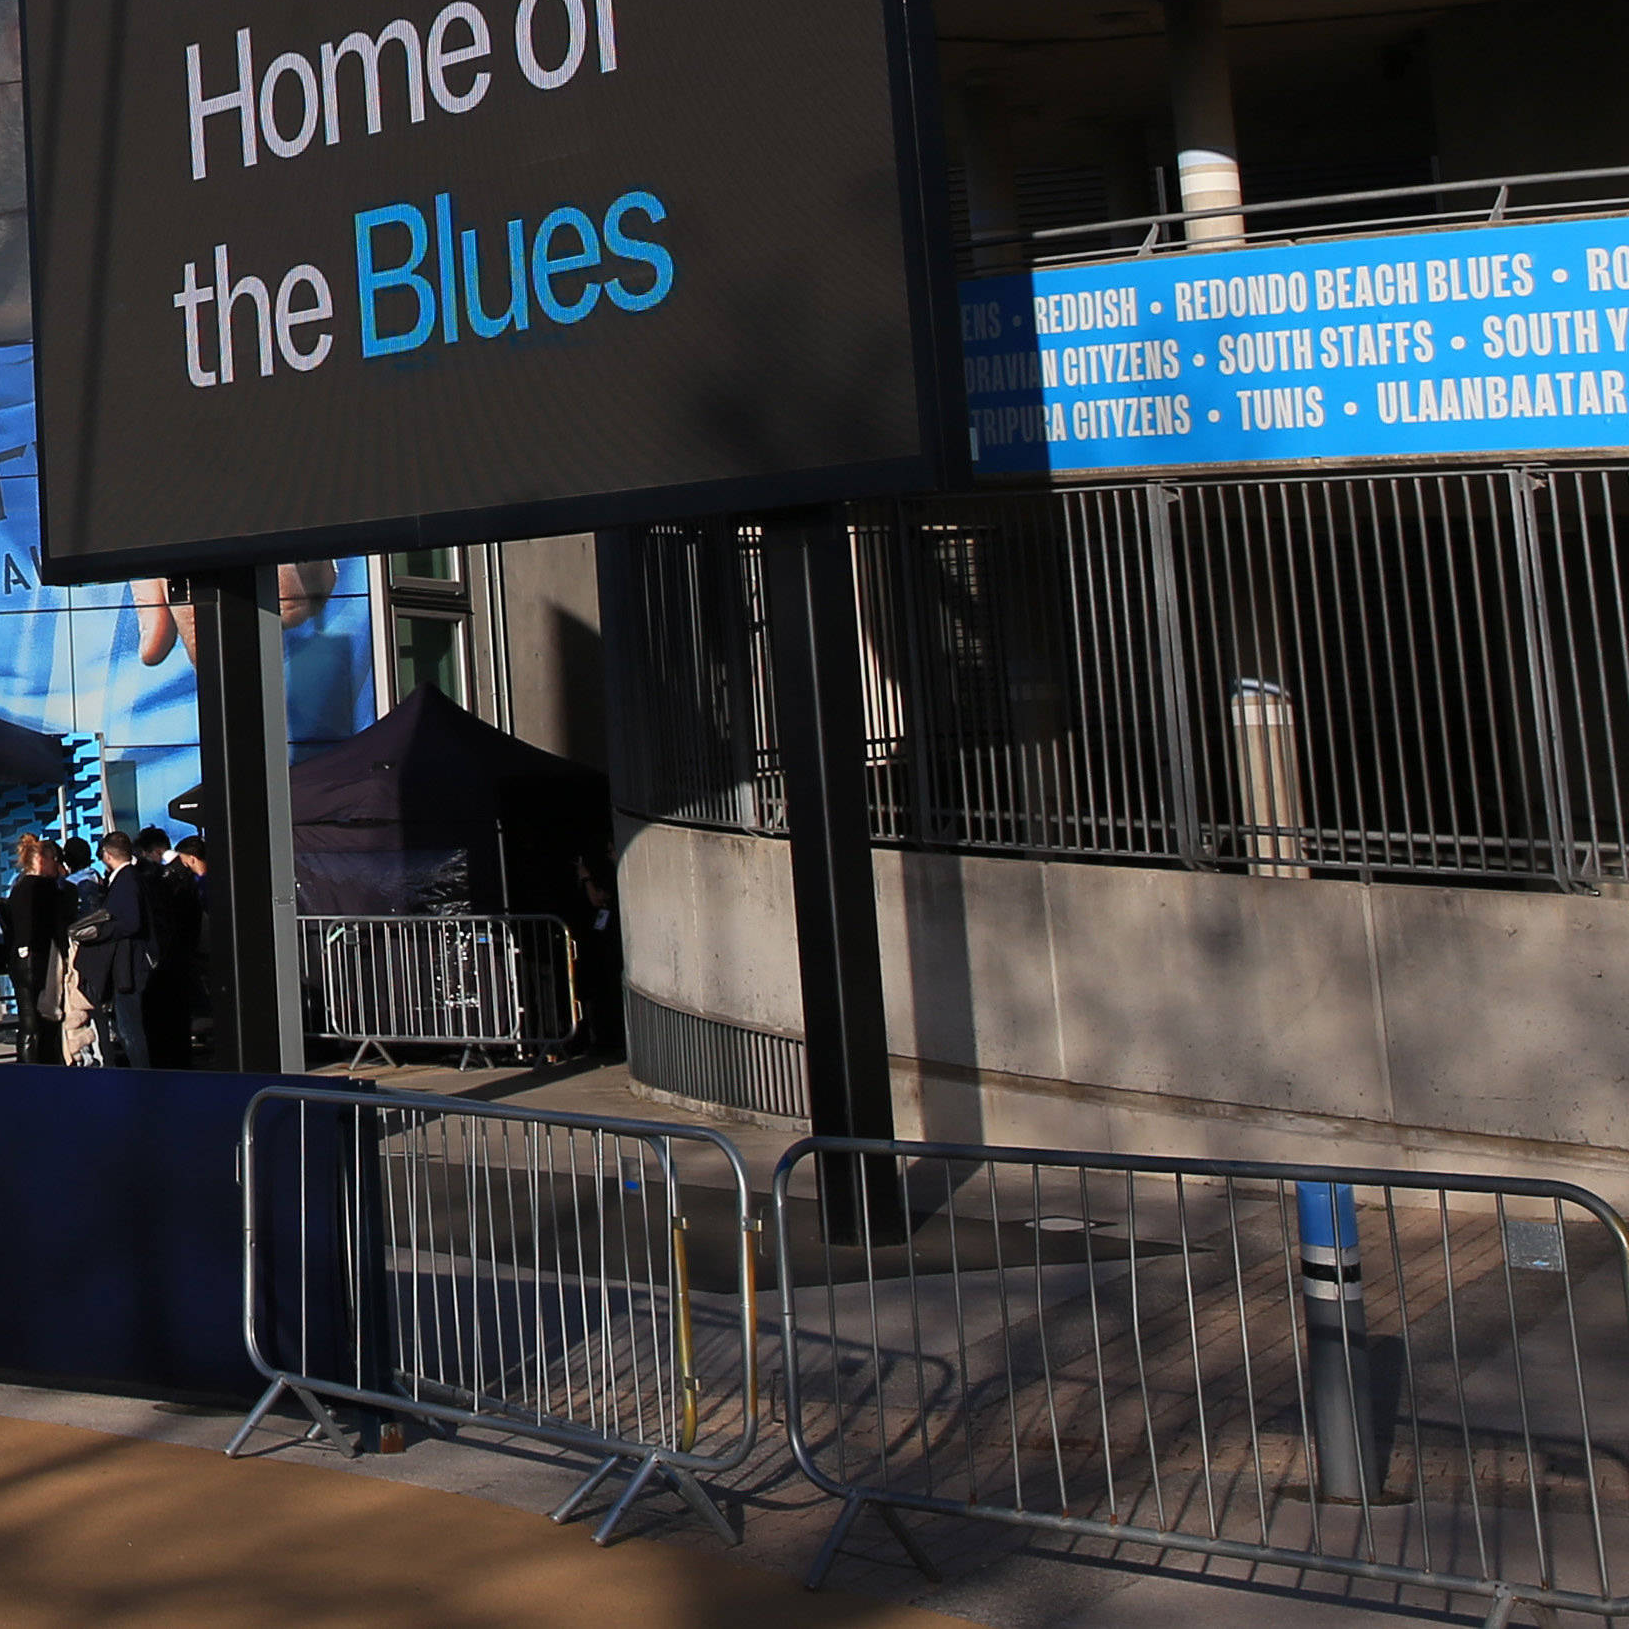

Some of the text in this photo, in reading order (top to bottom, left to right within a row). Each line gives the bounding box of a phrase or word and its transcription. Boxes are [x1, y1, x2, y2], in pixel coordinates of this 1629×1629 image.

[174, 190, 675, 388] the Blues
[1033, 287, 1138, 335] REDDISH
[1175, 271, 1307, 322] REDONDO
[1427, 252, 1534, 304] BLUES
[1063, 338, 1181, 387] CITYZENS
[1321, 320, 1433, 368] STAFFS
[1483, 308, 1599, 359] SOUTH
[971, 369, 1628, 446] TRIPURA CITYZENS ULAANBAATAR
